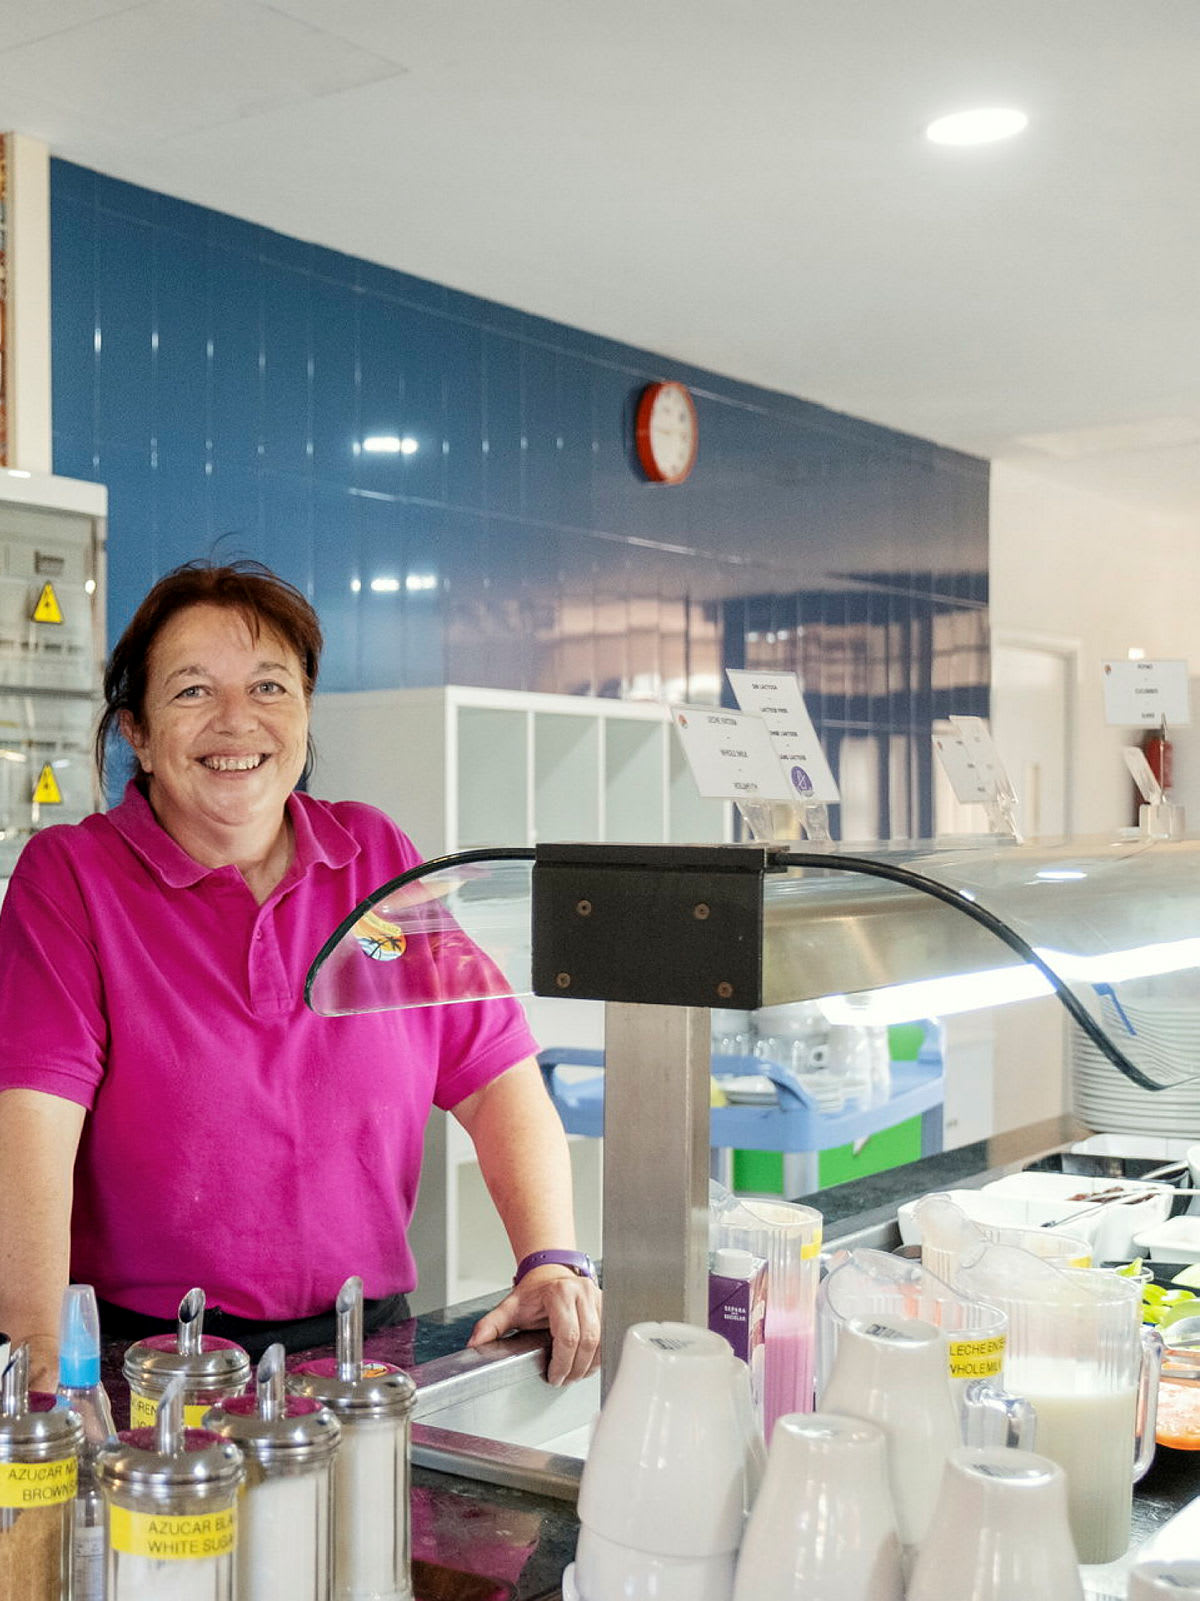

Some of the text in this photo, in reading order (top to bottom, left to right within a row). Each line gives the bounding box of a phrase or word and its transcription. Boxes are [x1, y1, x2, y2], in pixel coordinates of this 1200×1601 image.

[949, 1342, 986, 1356] LECHE
[8, 1466, 62, 1481] AZUCAR
[22, 1483, 69, 1501] BROWN
[148, 1520, 211, 1536] AZUCAR
[148, 1540, 198, 1555] WHITE
